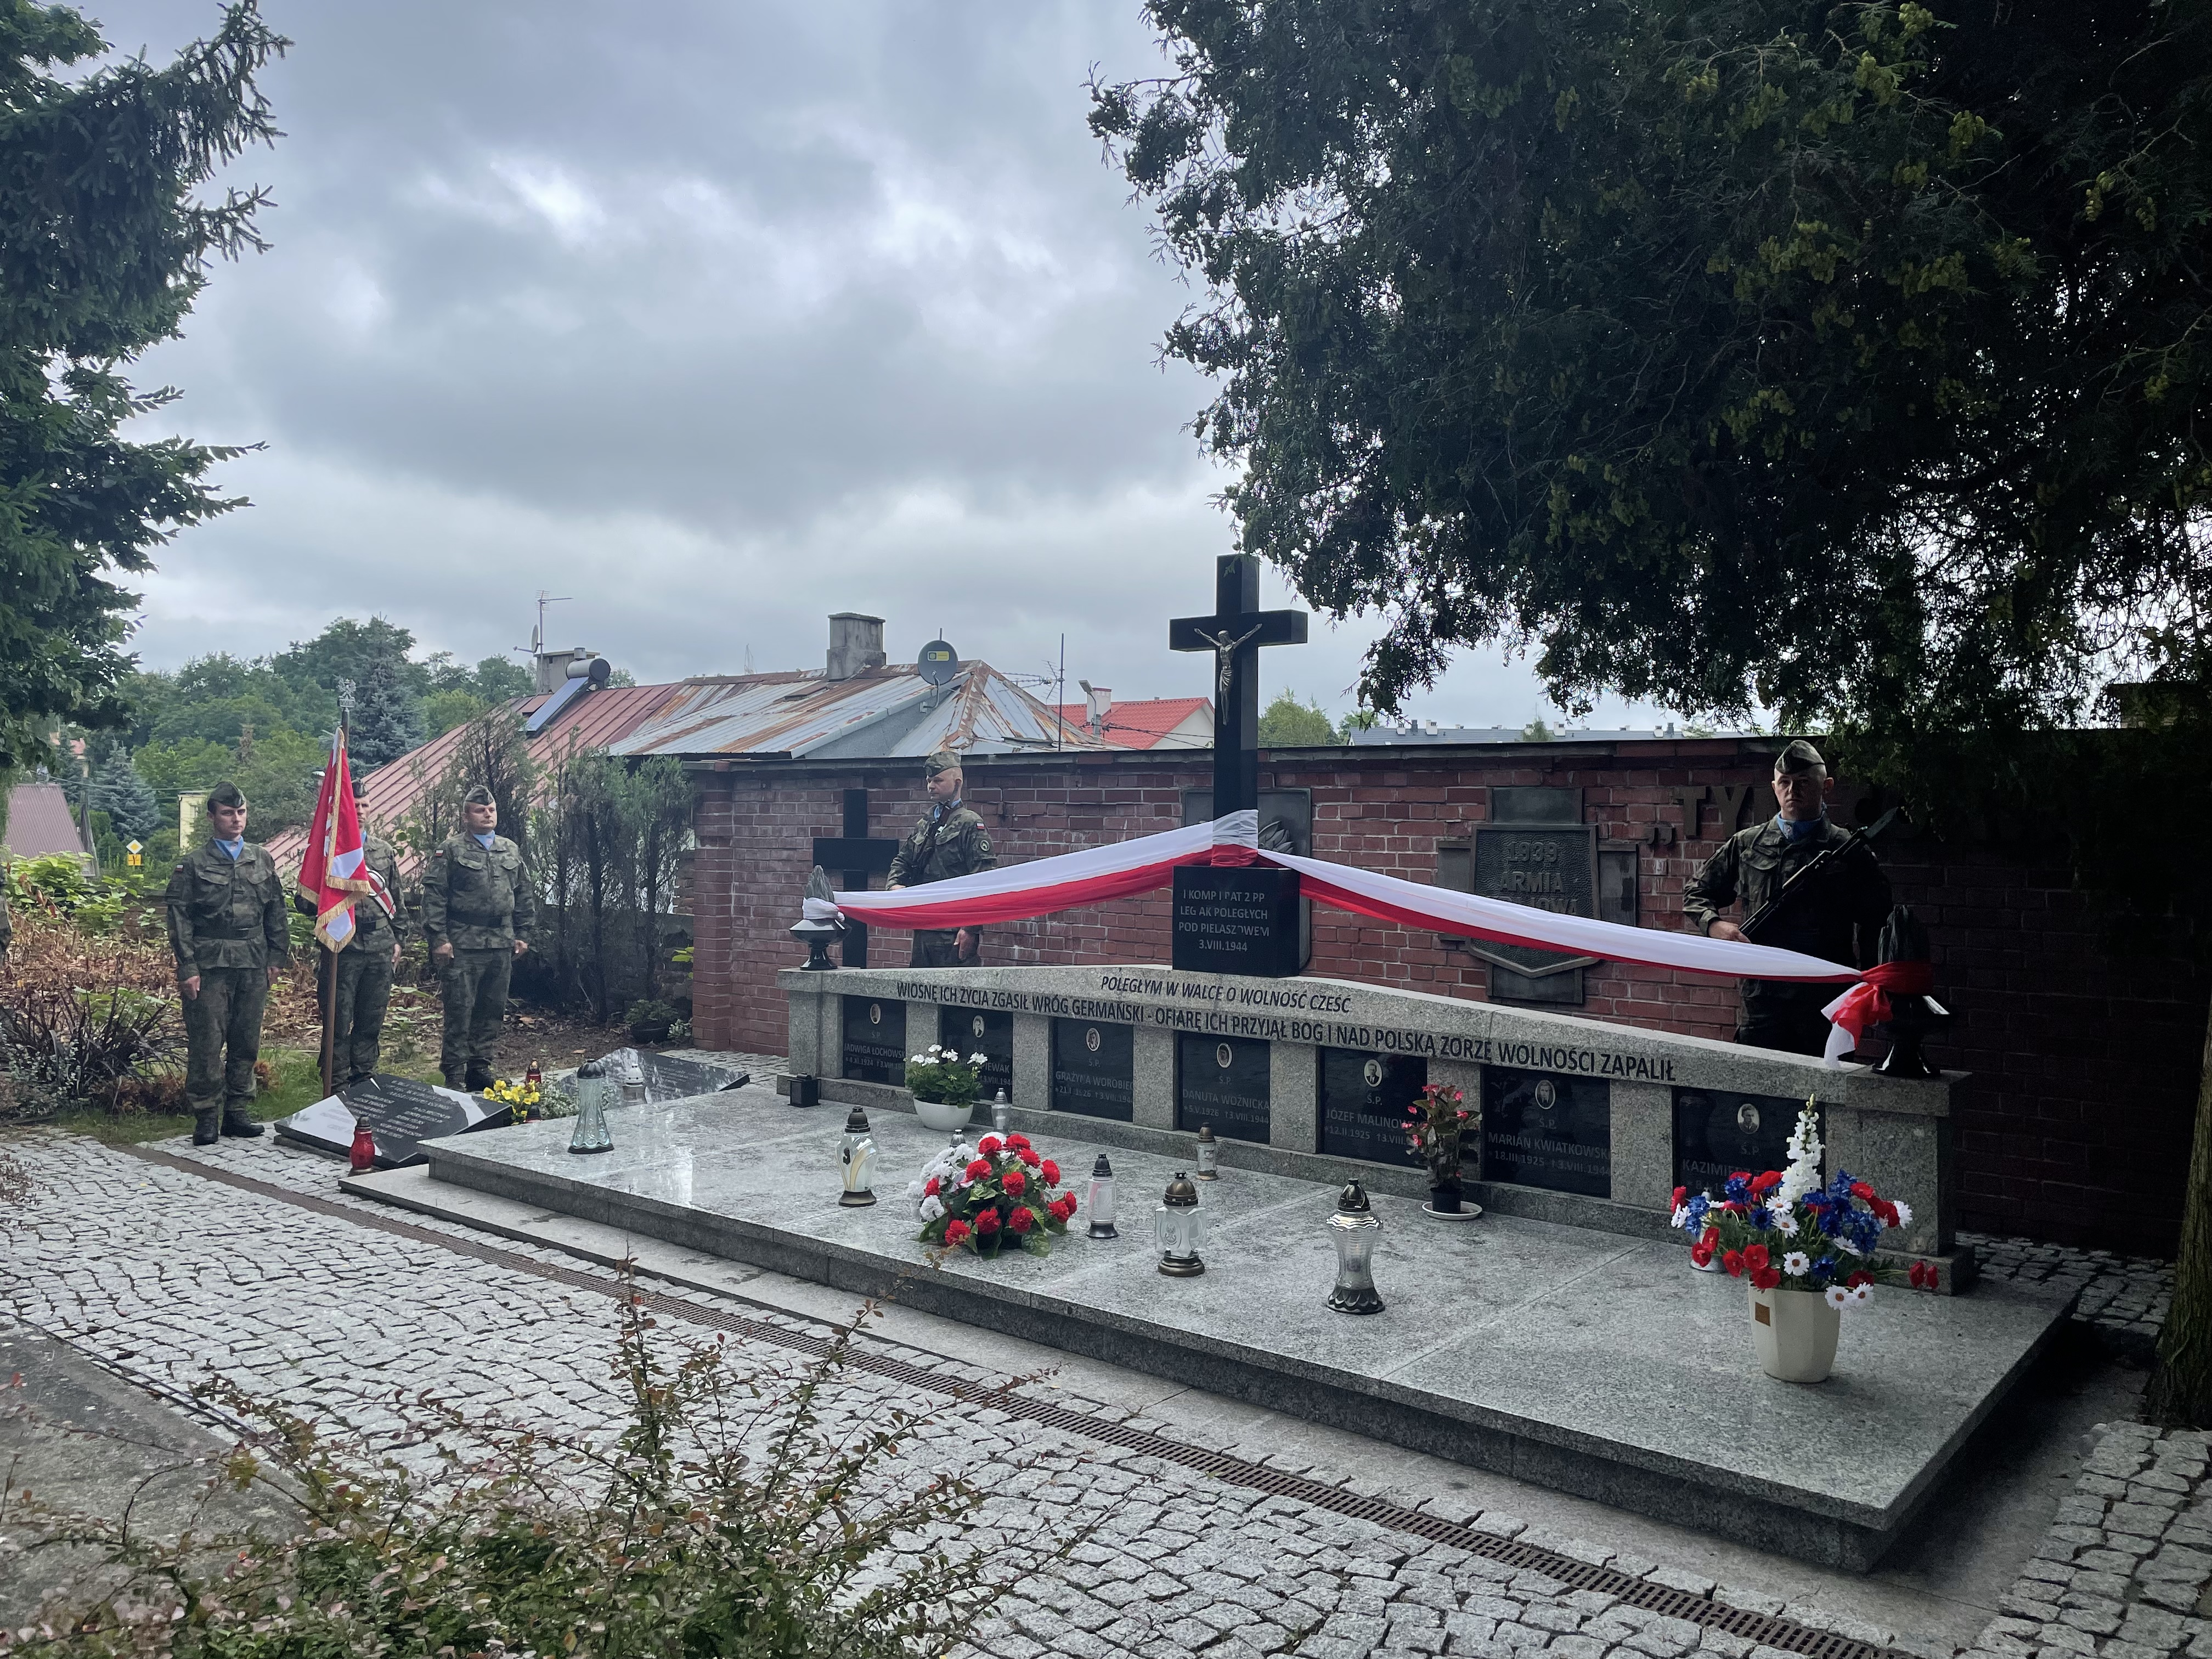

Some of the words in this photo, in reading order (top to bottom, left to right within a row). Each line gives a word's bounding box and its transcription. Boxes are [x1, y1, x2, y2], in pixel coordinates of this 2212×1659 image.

[1508, 841, 1558, 862] 1939
[1500, 871, 1564, 893] ARMIA
[1189, 890, 1217, 900] KOMP
[1244, 893, 1250, 902] 2
[1252, 893, 1265, 902] PP
[1181, 906, 1197, 915] LEG
[1199, 906, 1212, 917] AK
[1214, 907, 1268, 920] POLEGŁYCH
[1179, 922, 1198, 932] POD
[1199, 939, 1248, 952] 3.VIII.1944
[1101, 976, 1163, 995] POLEGŁYM
[1166, 981, 1179, 996] W
[1182, 983, 1223, 1001] WALCE
[1226, 987, 1237, 1002] O
[1240, 988, 1307, 1009] WOLNOŚĆ
[1310, 994, 1351, 1013] CZEŚĆ
[897, 982, 938, 1003] WIOSNĘ
[940, 986, 957, 1002] ICH
[960, 986, 989, 1006] ŻYCIA
[992, 991, 1029, 1010] ZGASIŁ
[1032, 995, 1068, 1014] WRÓG
[1155, 1008, 1201, 1031] OFIARĘ
[1206, 1013, 1227, 1032] ICH
[1233, 1016, 1287, 1040] PRZYJĄŁ
[1328, 1025, 1331, 1042] I
[1337, 1026, 1370, 1046] NAD
[1375, 1029, 1436, 1057] POLSKĄ
[1498, 1042, 1594, 1072] WOLNOŚCI
[1601, 1054, 1676, 1081] ZAPALIŁ
[844, 1043, 871, 1054] JADWIGA
[872, 1047, 905, 1059] ŁOCHOWSK
[1183, 1088, 1219, 1104] DANUTA
[1221, 1094, 1269, 1110] WOŹNICKA
[1326, 1107, 1355, 1122] JÓZEF
[1488, 1132, 1531, 1148] MARIAN
